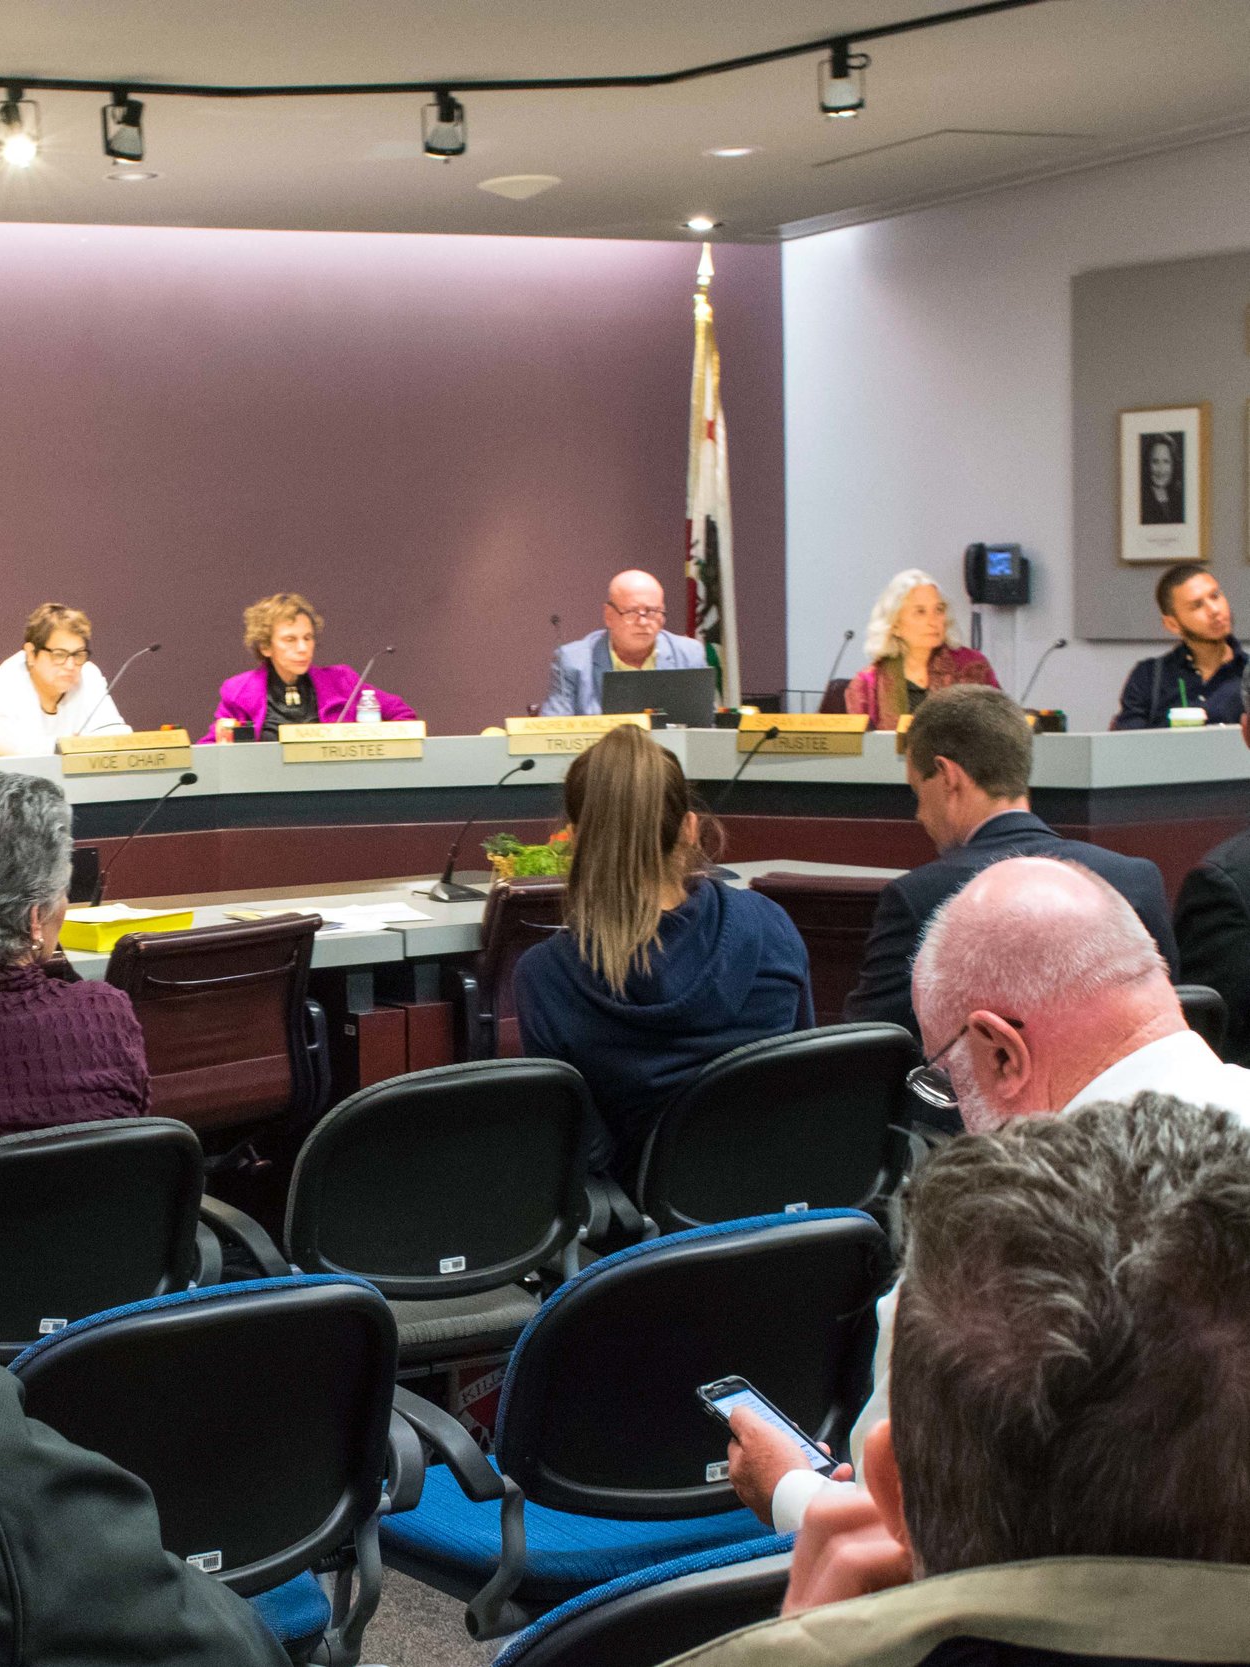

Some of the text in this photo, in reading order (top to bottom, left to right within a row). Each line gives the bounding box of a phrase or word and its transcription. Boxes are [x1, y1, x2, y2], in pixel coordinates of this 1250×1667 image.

[321, 743, 385, 758] TRUSTEE
[88, 752, 166, 769] VICE CHAIR
